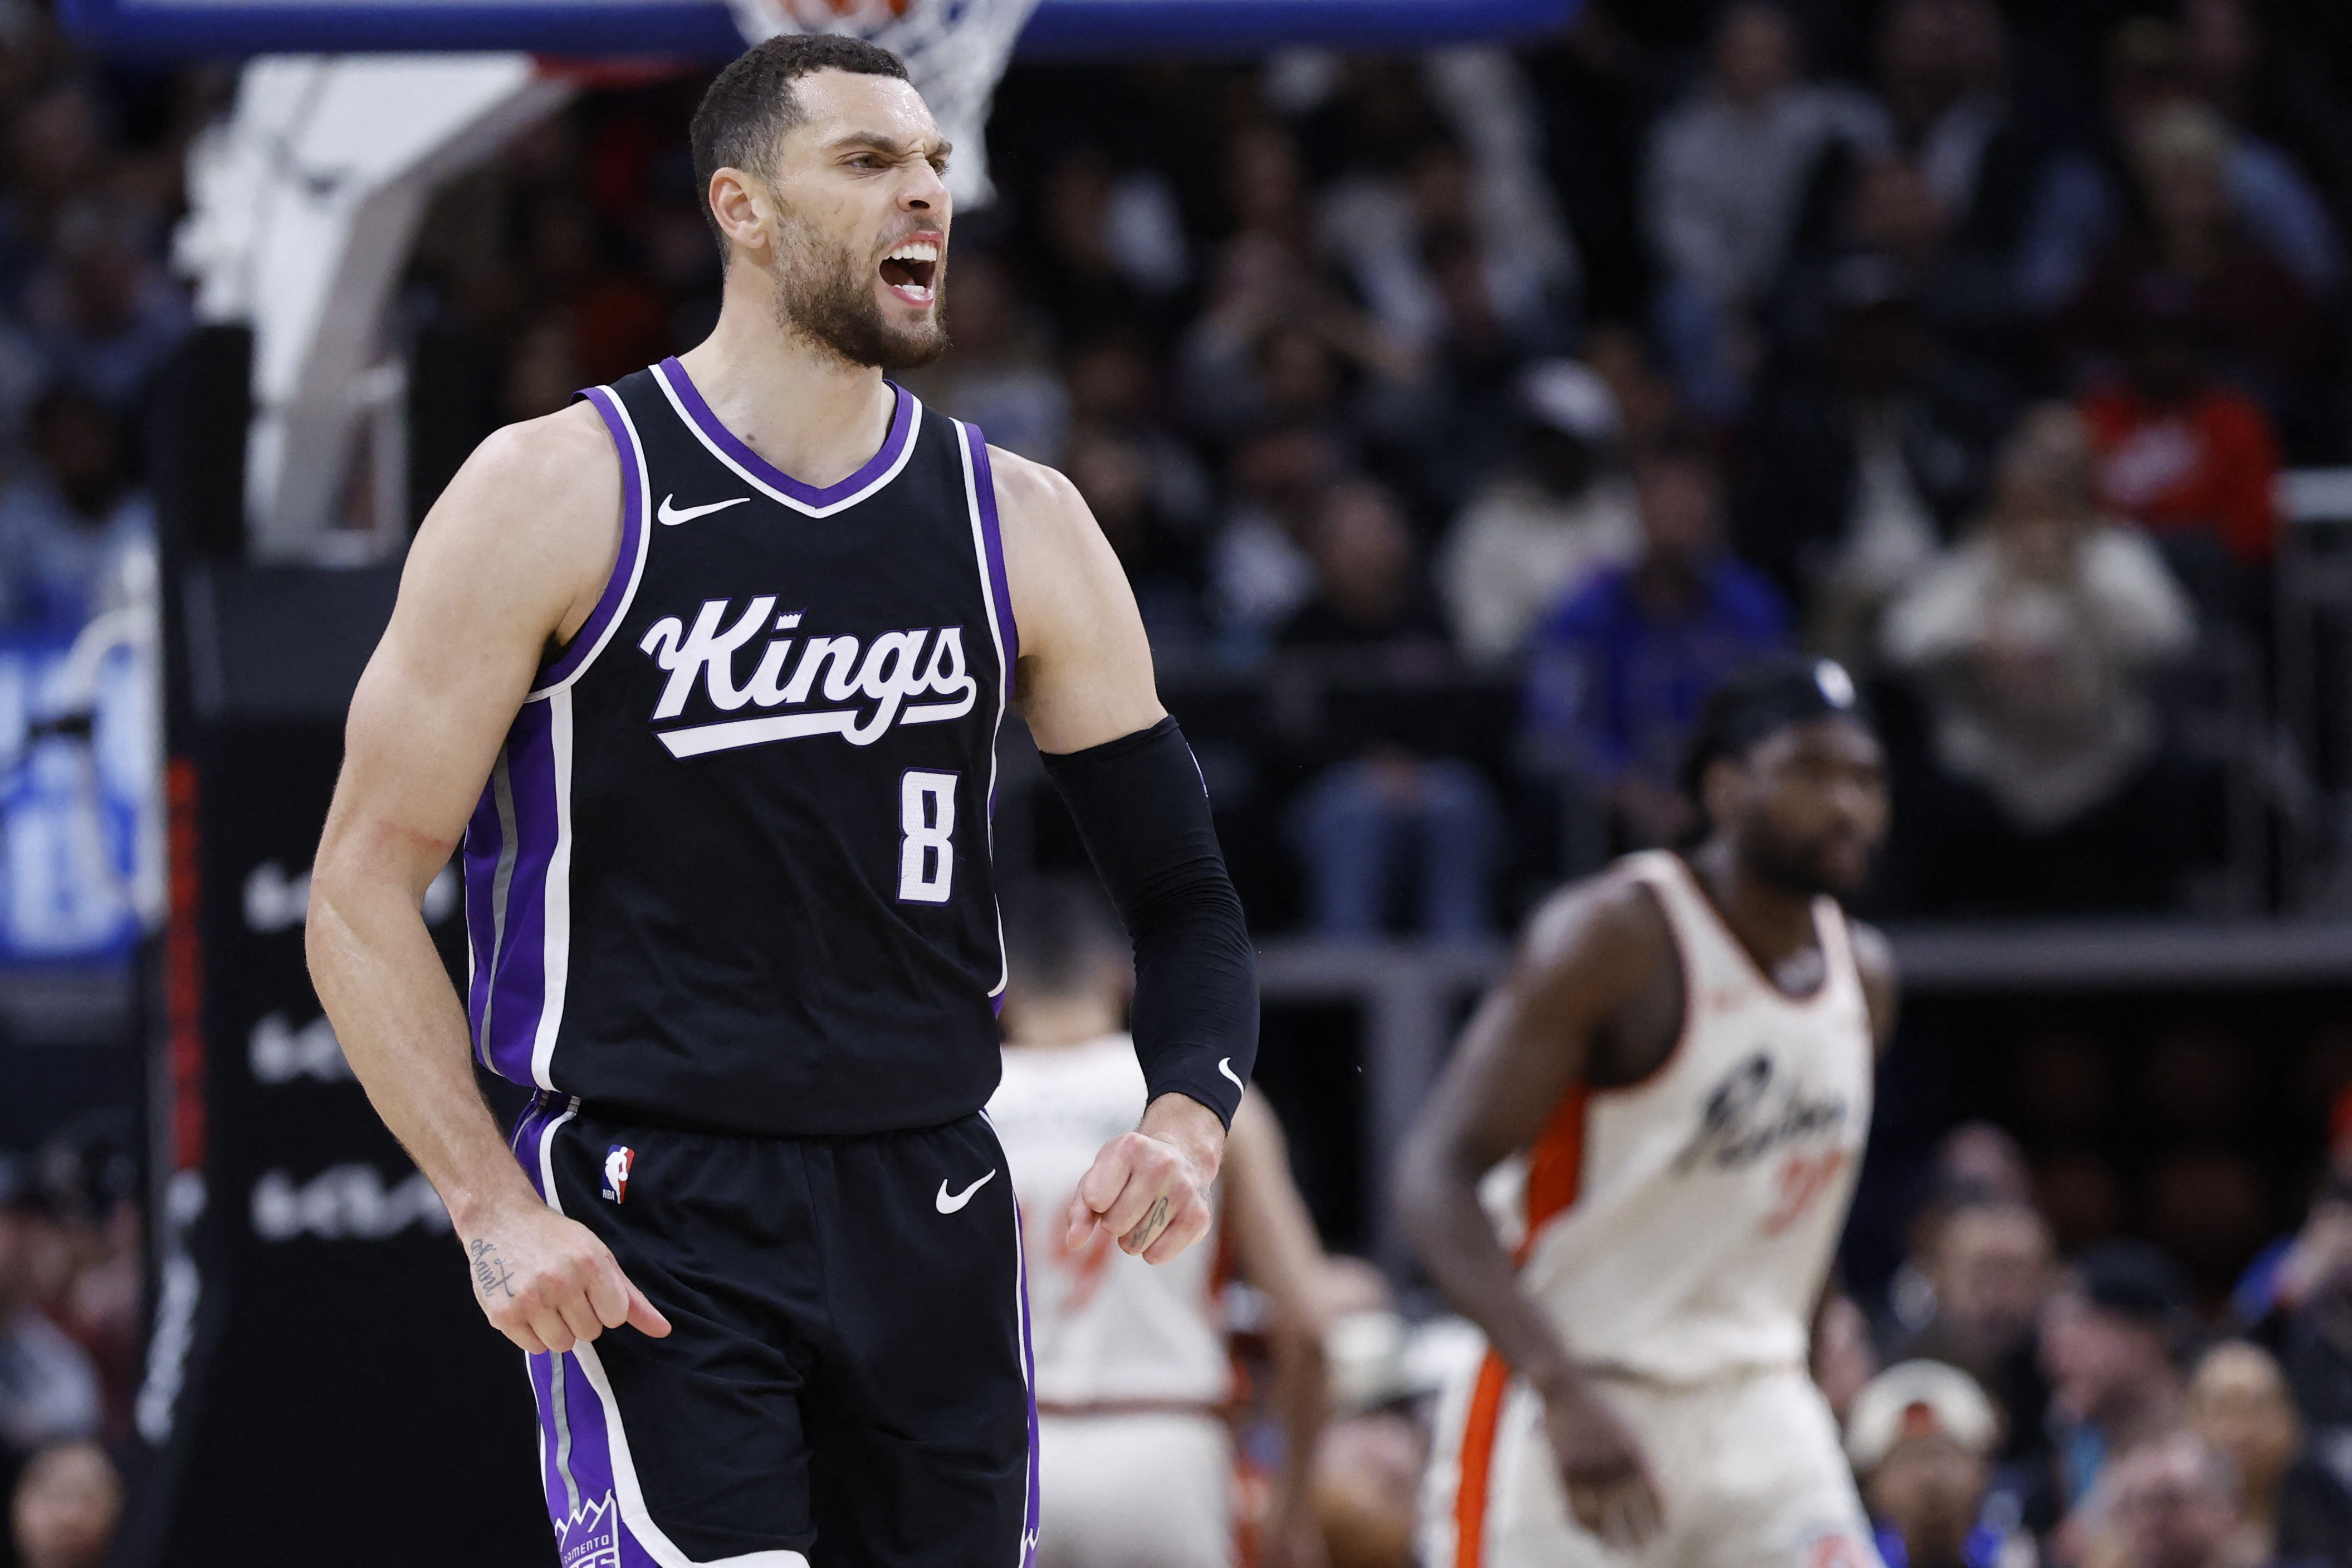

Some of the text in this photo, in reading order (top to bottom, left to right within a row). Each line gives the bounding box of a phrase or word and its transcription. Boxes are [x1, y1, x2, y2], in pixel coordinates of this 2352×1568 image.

[637, 594, 977, 760] Kings
[896, 767, 962, 906] 8
[602, 1188, 615, 1200] NBA
